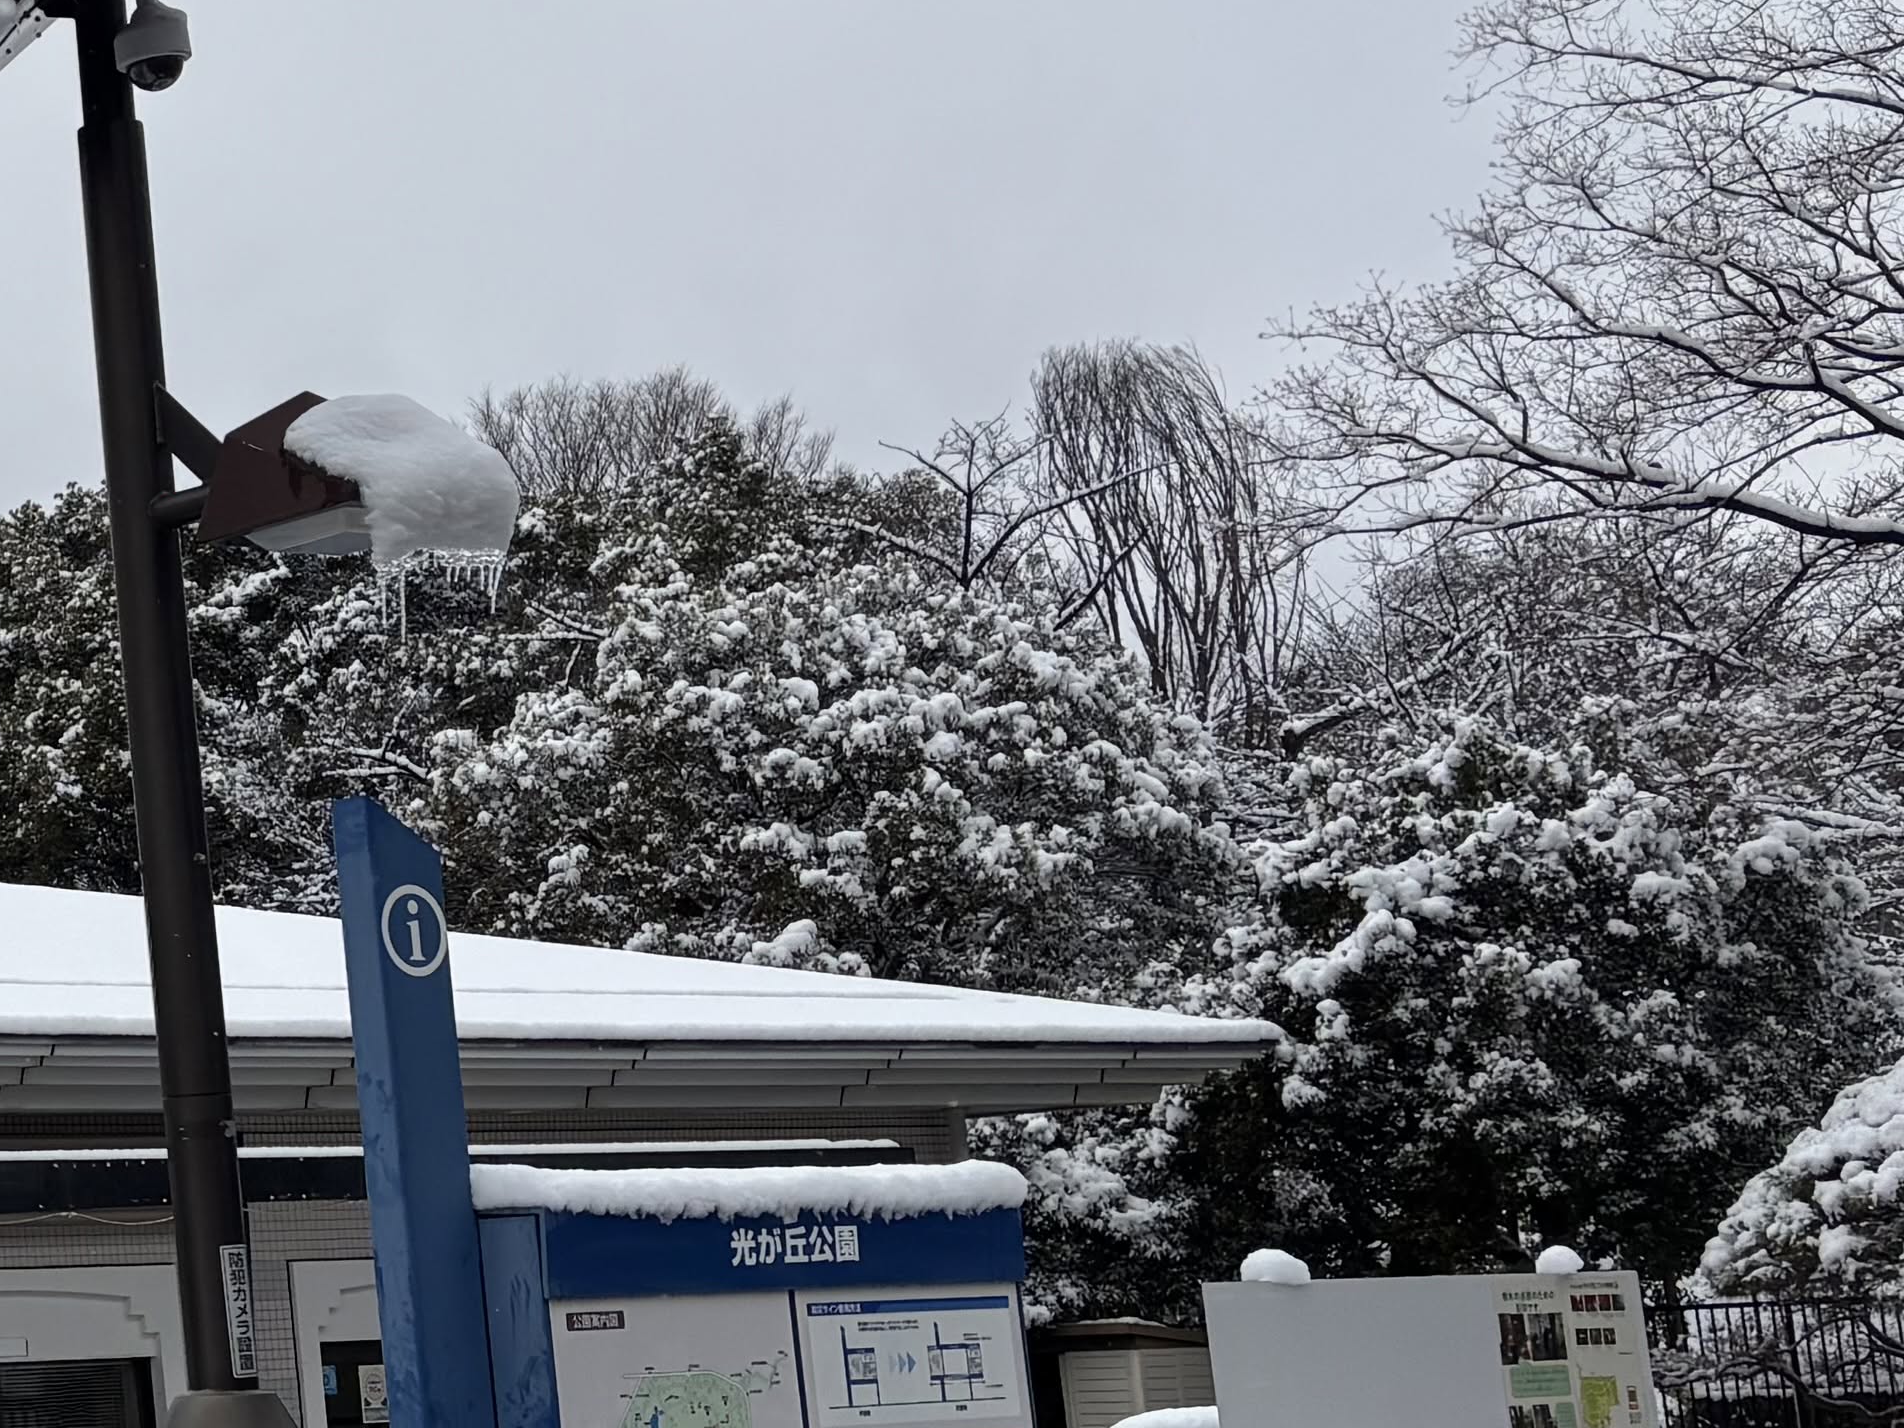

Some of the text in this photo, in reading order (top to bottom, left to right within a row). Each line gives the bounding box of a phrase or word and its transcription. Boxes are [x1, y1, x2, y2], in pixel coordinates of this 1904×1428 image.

[730, 1225, 860, 1266] 光が丘公園
[228, 1252, 254, 1371] 防犯カメラ設置
